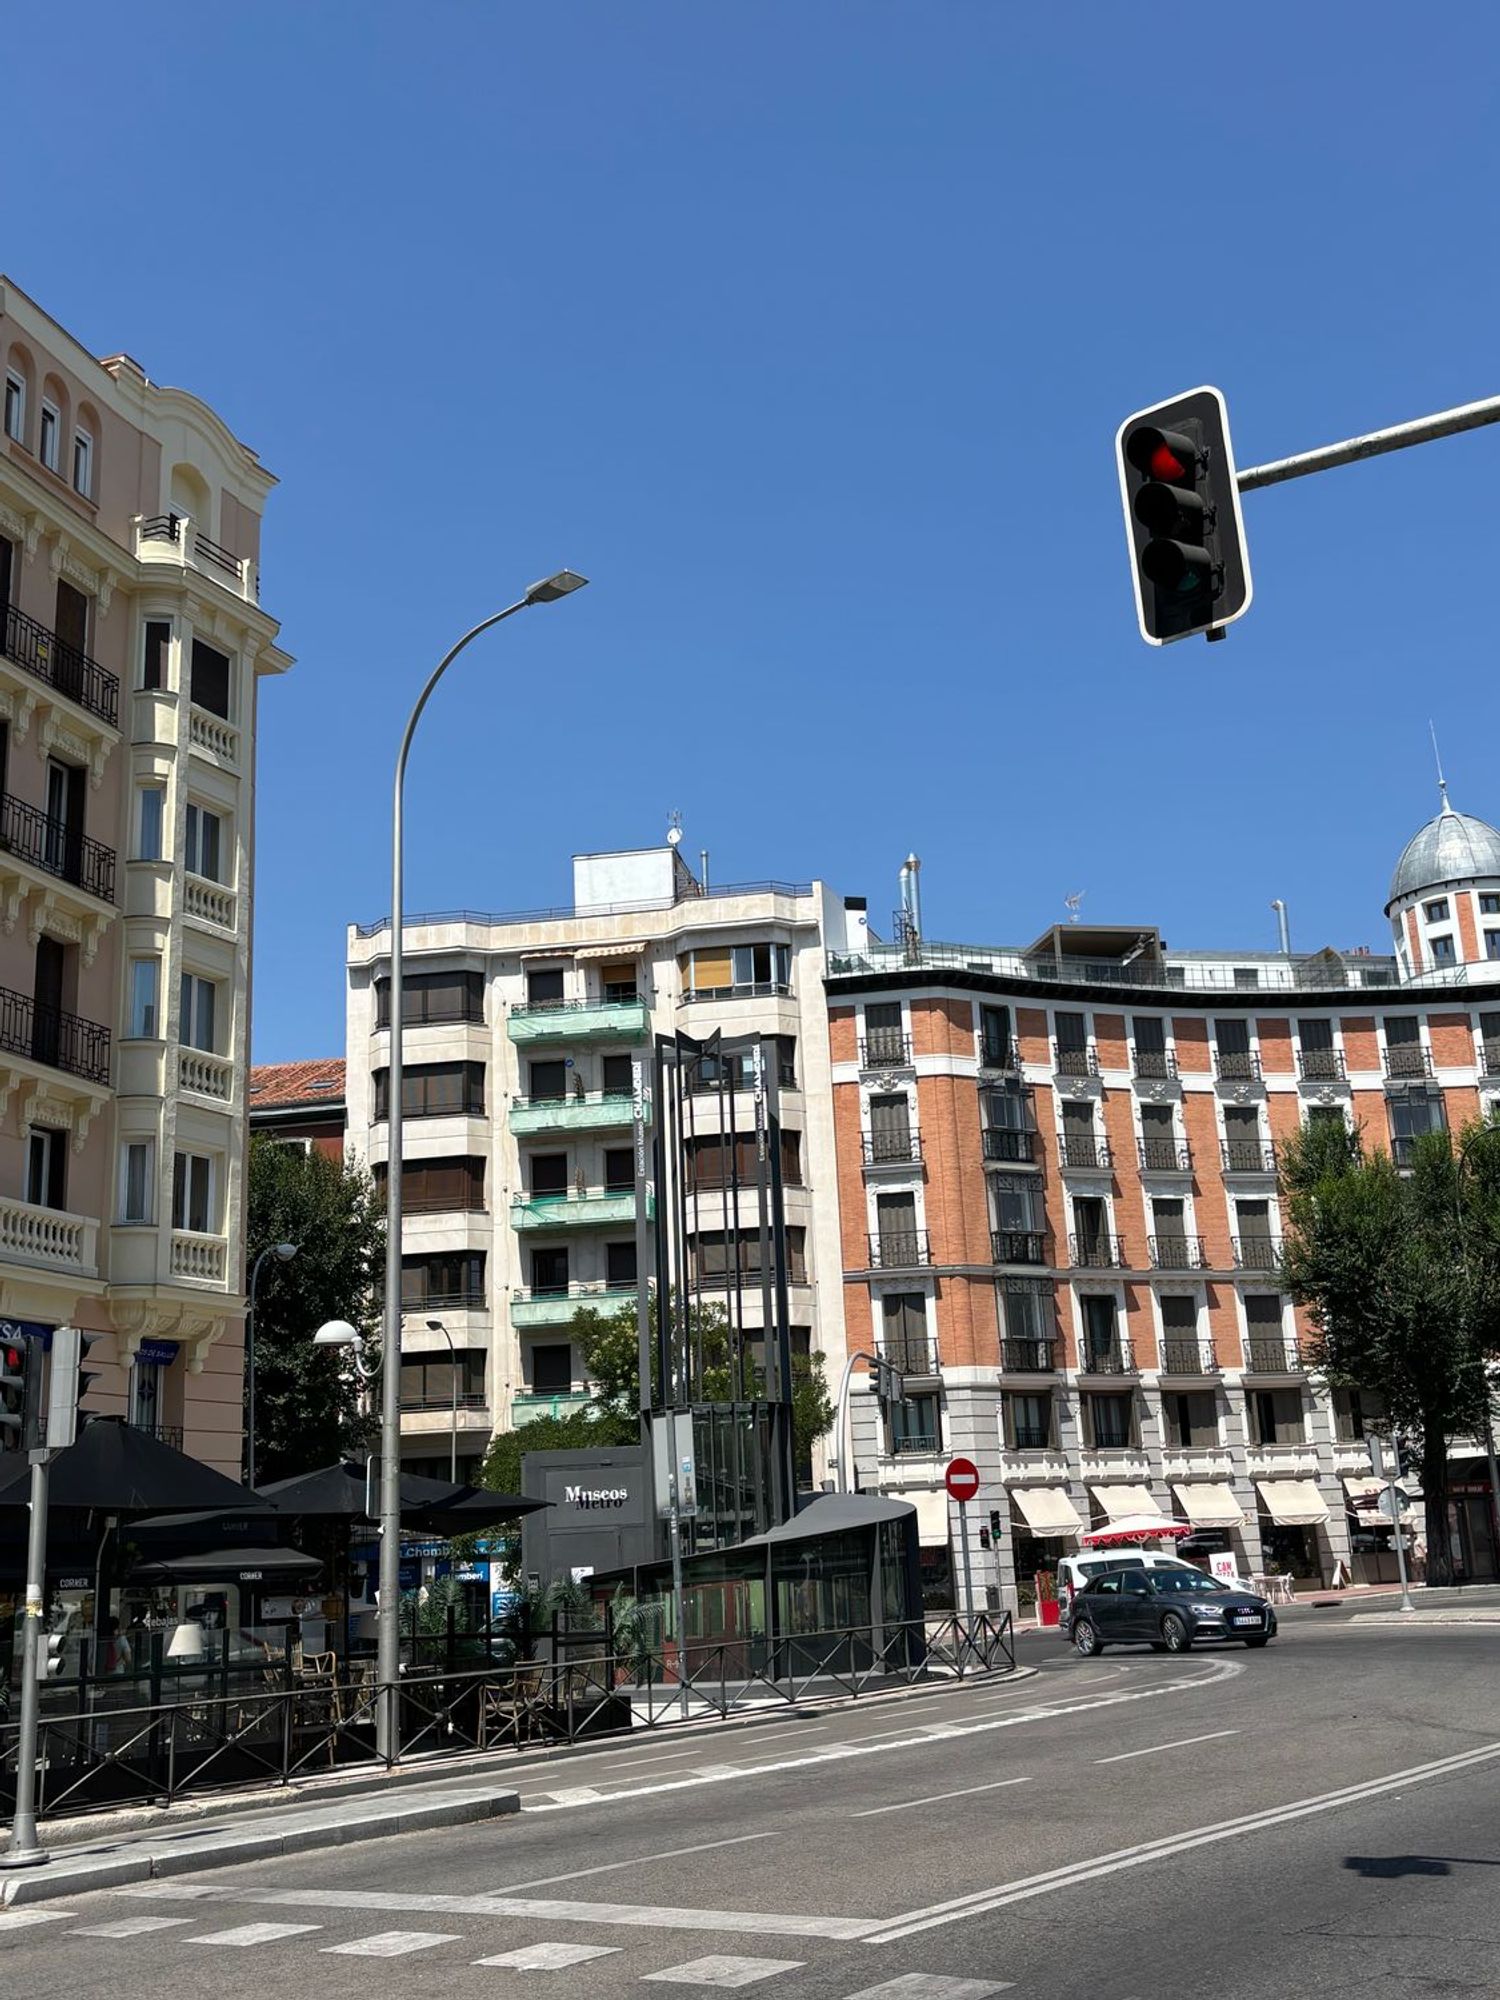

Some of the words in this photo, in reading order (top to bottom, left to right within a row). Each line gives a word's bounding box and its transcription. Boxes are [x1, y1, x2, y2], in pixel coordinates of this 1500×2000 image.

[752, 1044, 762, 1102] CHAMBERÍ
[632, 1061, 643, 1119] CHAMBERÍ
[564, 1485, 628, 1502] Museos
[575, 1495, 623, 1510] Metro
[60, 1578, 89, 1588] CORNER
[240, 1571, 262, 1580] CORNER
